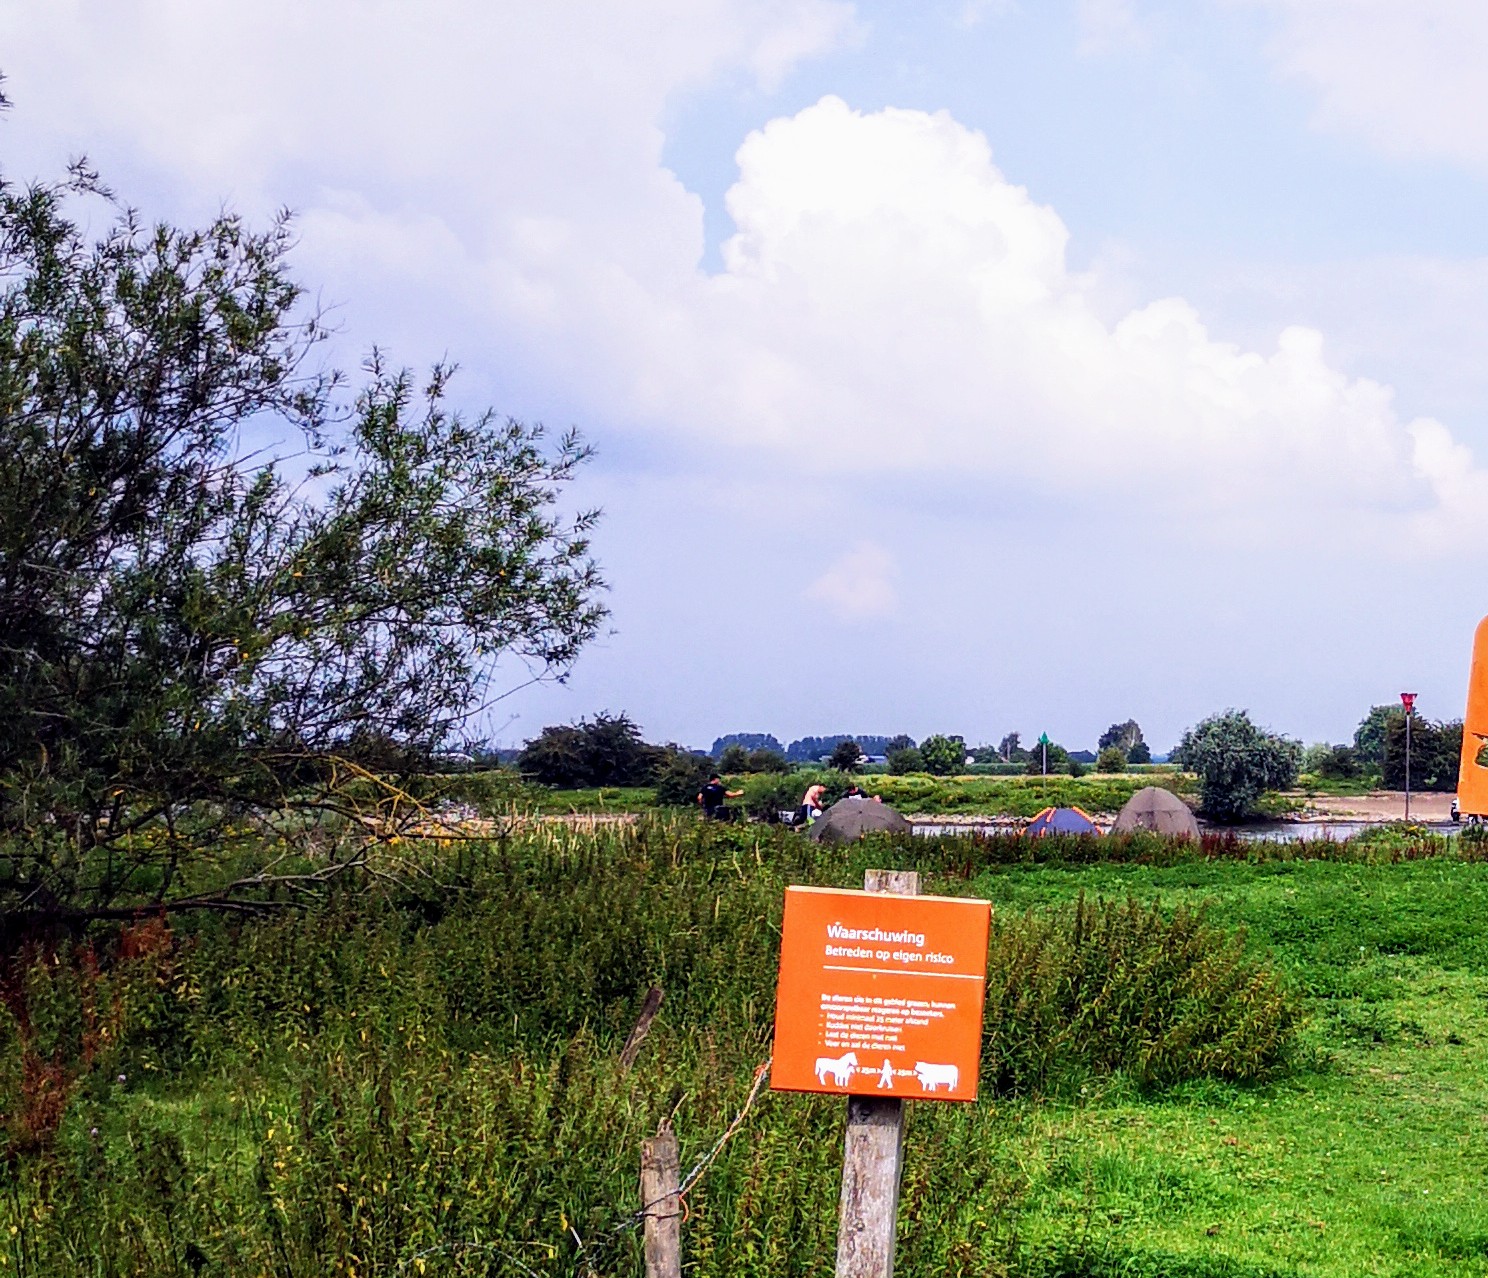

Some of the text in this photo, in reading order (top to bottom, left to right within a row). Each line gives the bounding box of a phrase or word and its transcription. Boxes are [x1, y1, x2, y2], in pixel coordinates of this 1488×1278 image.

[827, 924, 925, 946] Waarschuwing
[825, 945, 954, 964] Betreden op eigen risico
